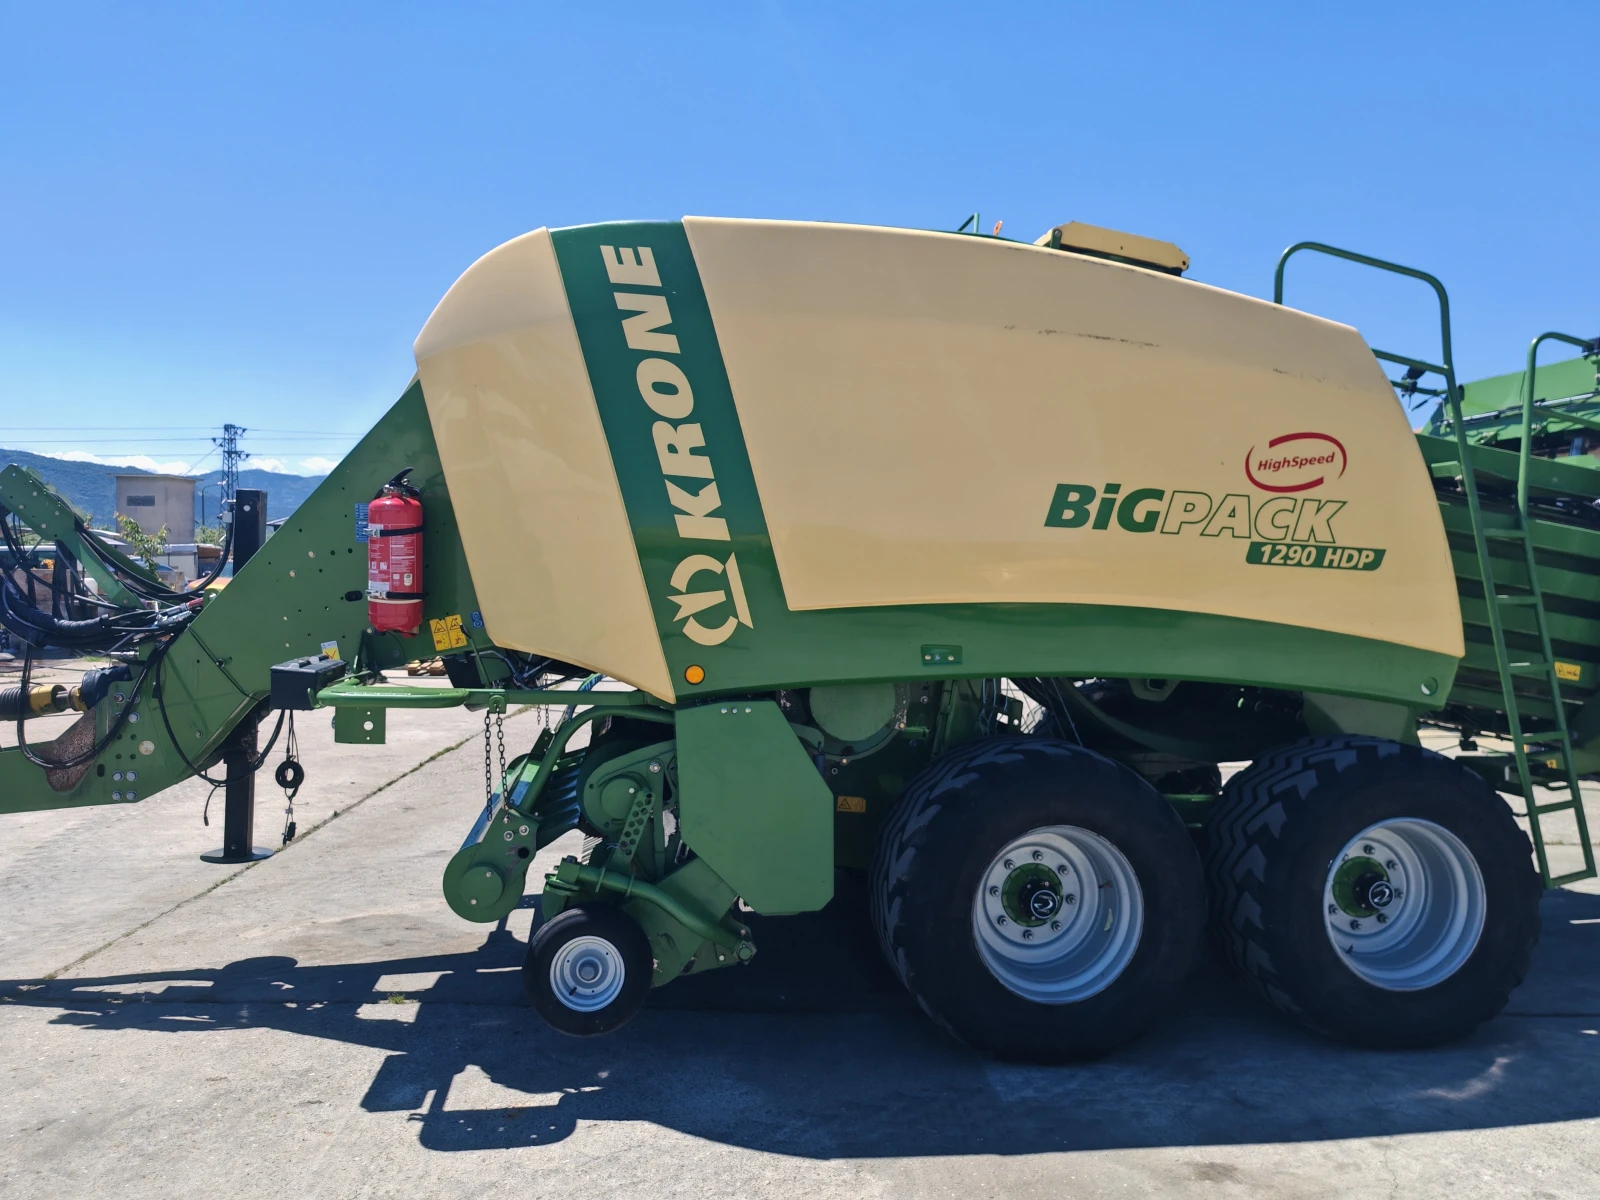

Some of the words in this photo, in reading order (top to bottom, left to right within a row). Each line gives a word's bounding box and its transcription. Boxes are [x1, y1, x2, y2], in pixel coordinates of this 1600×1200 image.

[600, 245, 731, 541] KRONE
[1257, 452, 1335, 472] HighSpeed
[1260, 544, 1316, 567] 1290
[1323, 548, 1375, 570] HDP
